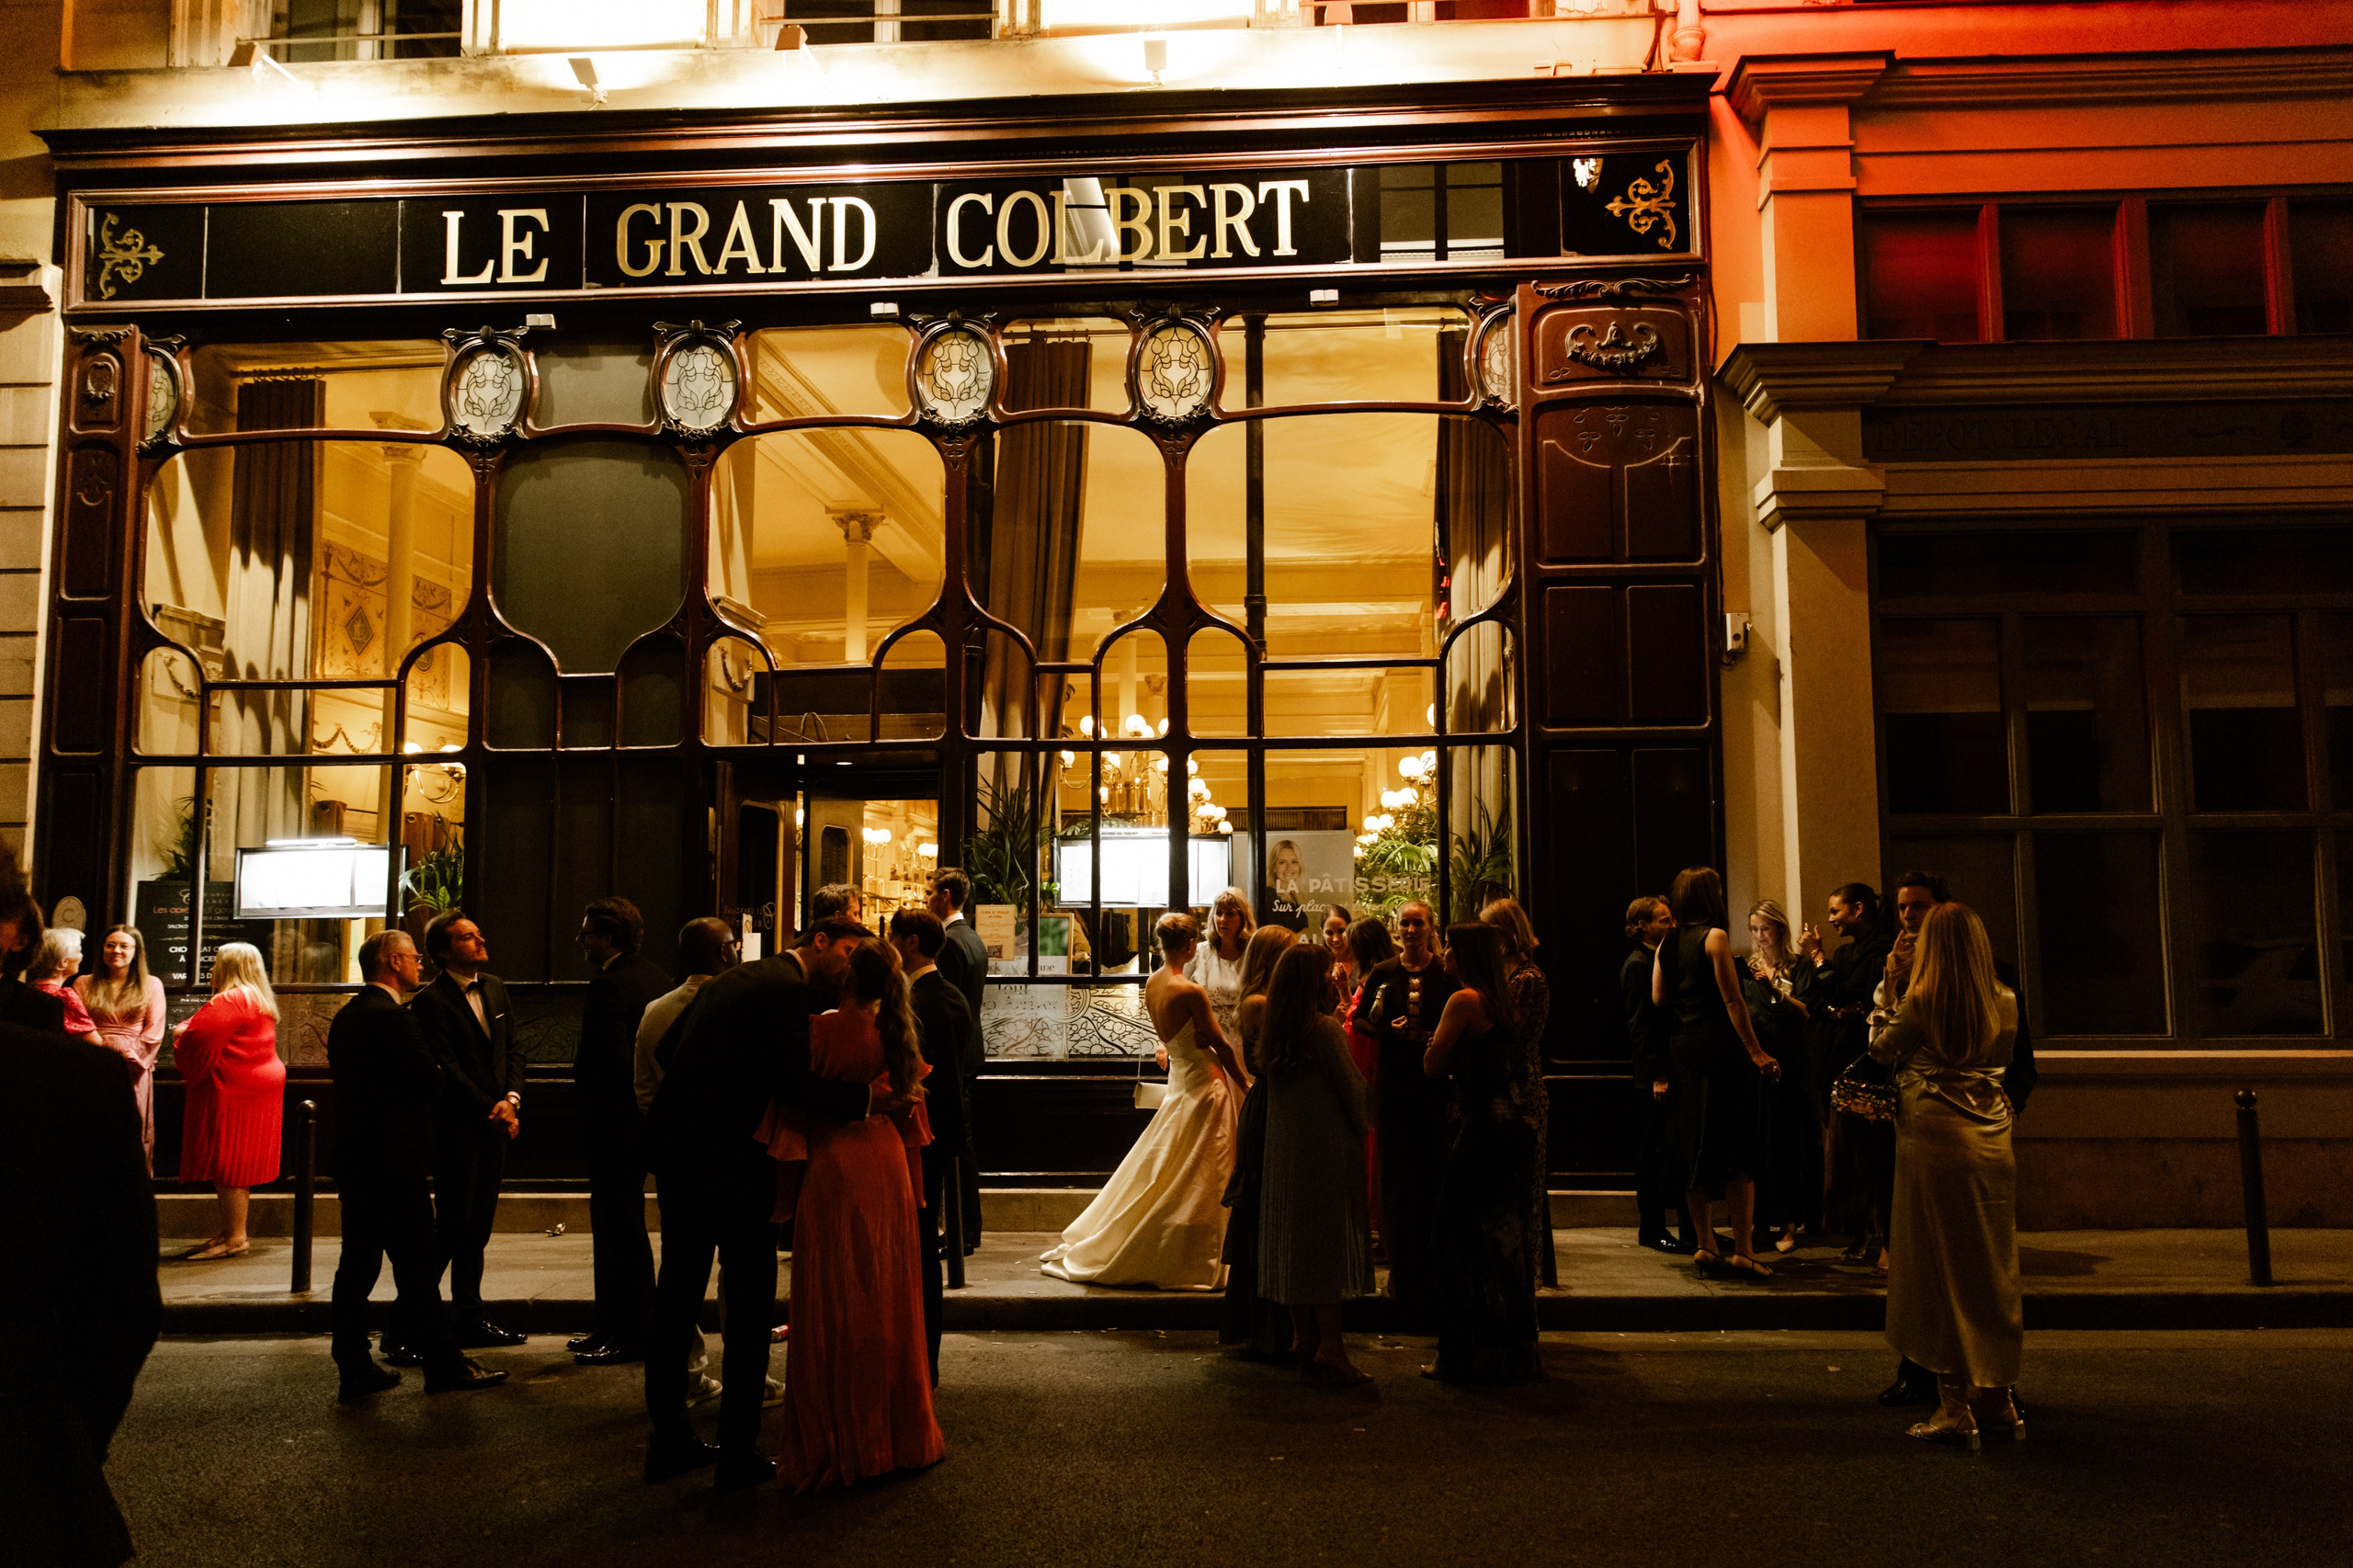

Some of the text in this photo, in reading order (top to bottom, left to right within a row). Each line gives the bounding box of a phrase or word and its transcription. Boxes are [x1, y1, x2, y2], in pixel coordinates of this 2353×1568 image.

[439, 179, 1310, 286] LE GRAND COLBERT
[1875, 416, 2130, 452] DEPOT LEGAL
[1276, 873, 1430, 893] LA PÂTISSERIE
[1271, 899, 1294, 913] Sur
[1294, 898, 1326, 918] plac
